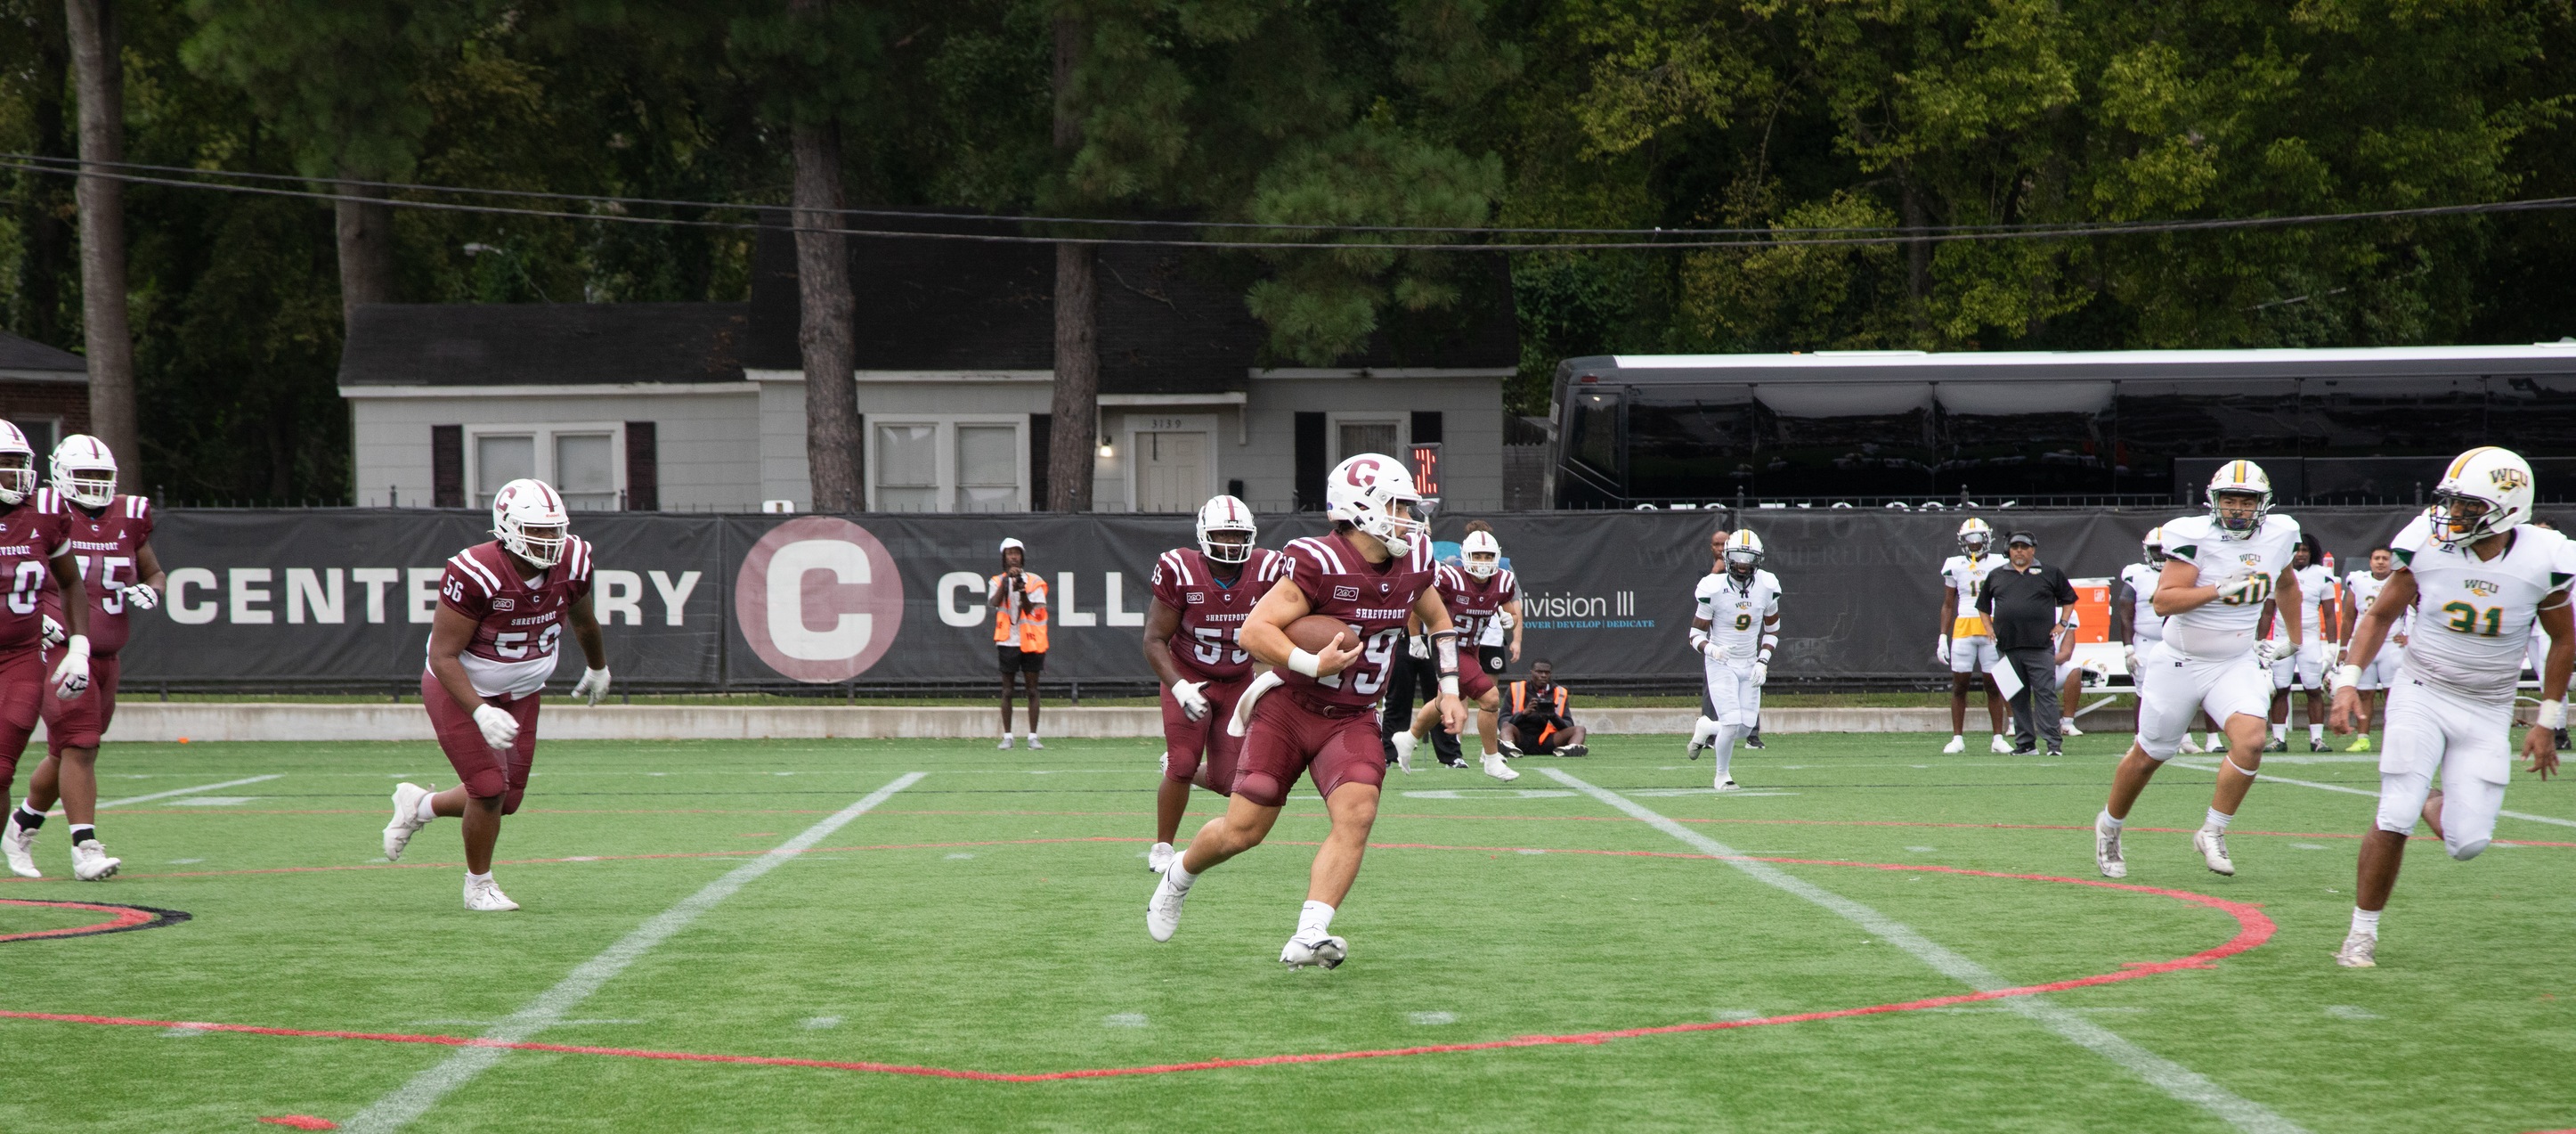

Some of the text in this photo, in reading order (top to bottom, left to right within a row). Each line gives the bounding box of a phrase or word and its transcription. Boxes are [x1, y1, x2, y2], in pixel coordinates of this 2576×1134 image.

[1151, 419, 1182, 428] 3139
[1346, 459, 1380, 487] C
[2490, 468, 2529, 487] WCU
[495, 486, 517, 512] C
[91, 524, 100, 532] C
[72, 541, 119, 551] SHREVEPORT
[2239, 553, 2261, 562] WCU
[443, 575, 465, 603] 56
[1381, 583, 1389, 592] C
[2464, 579, 2499, 594] WCU
[166, 567, 703, 626] CENTERY
[533, 595, 540, 603] C
[766, 539, 873, 661] C
[1520, 591, 1606, 617] ivision
[511, 610, 557, 626] SHREVEPORT
[1355, 608, 1406, 619] SHREVEPORT
[2442, 600, 2504, 637] 31
[1523, 619, 1655, 629] COVER DEVELOP DEDICATE
[1735, 614, 1752, 631] 9
